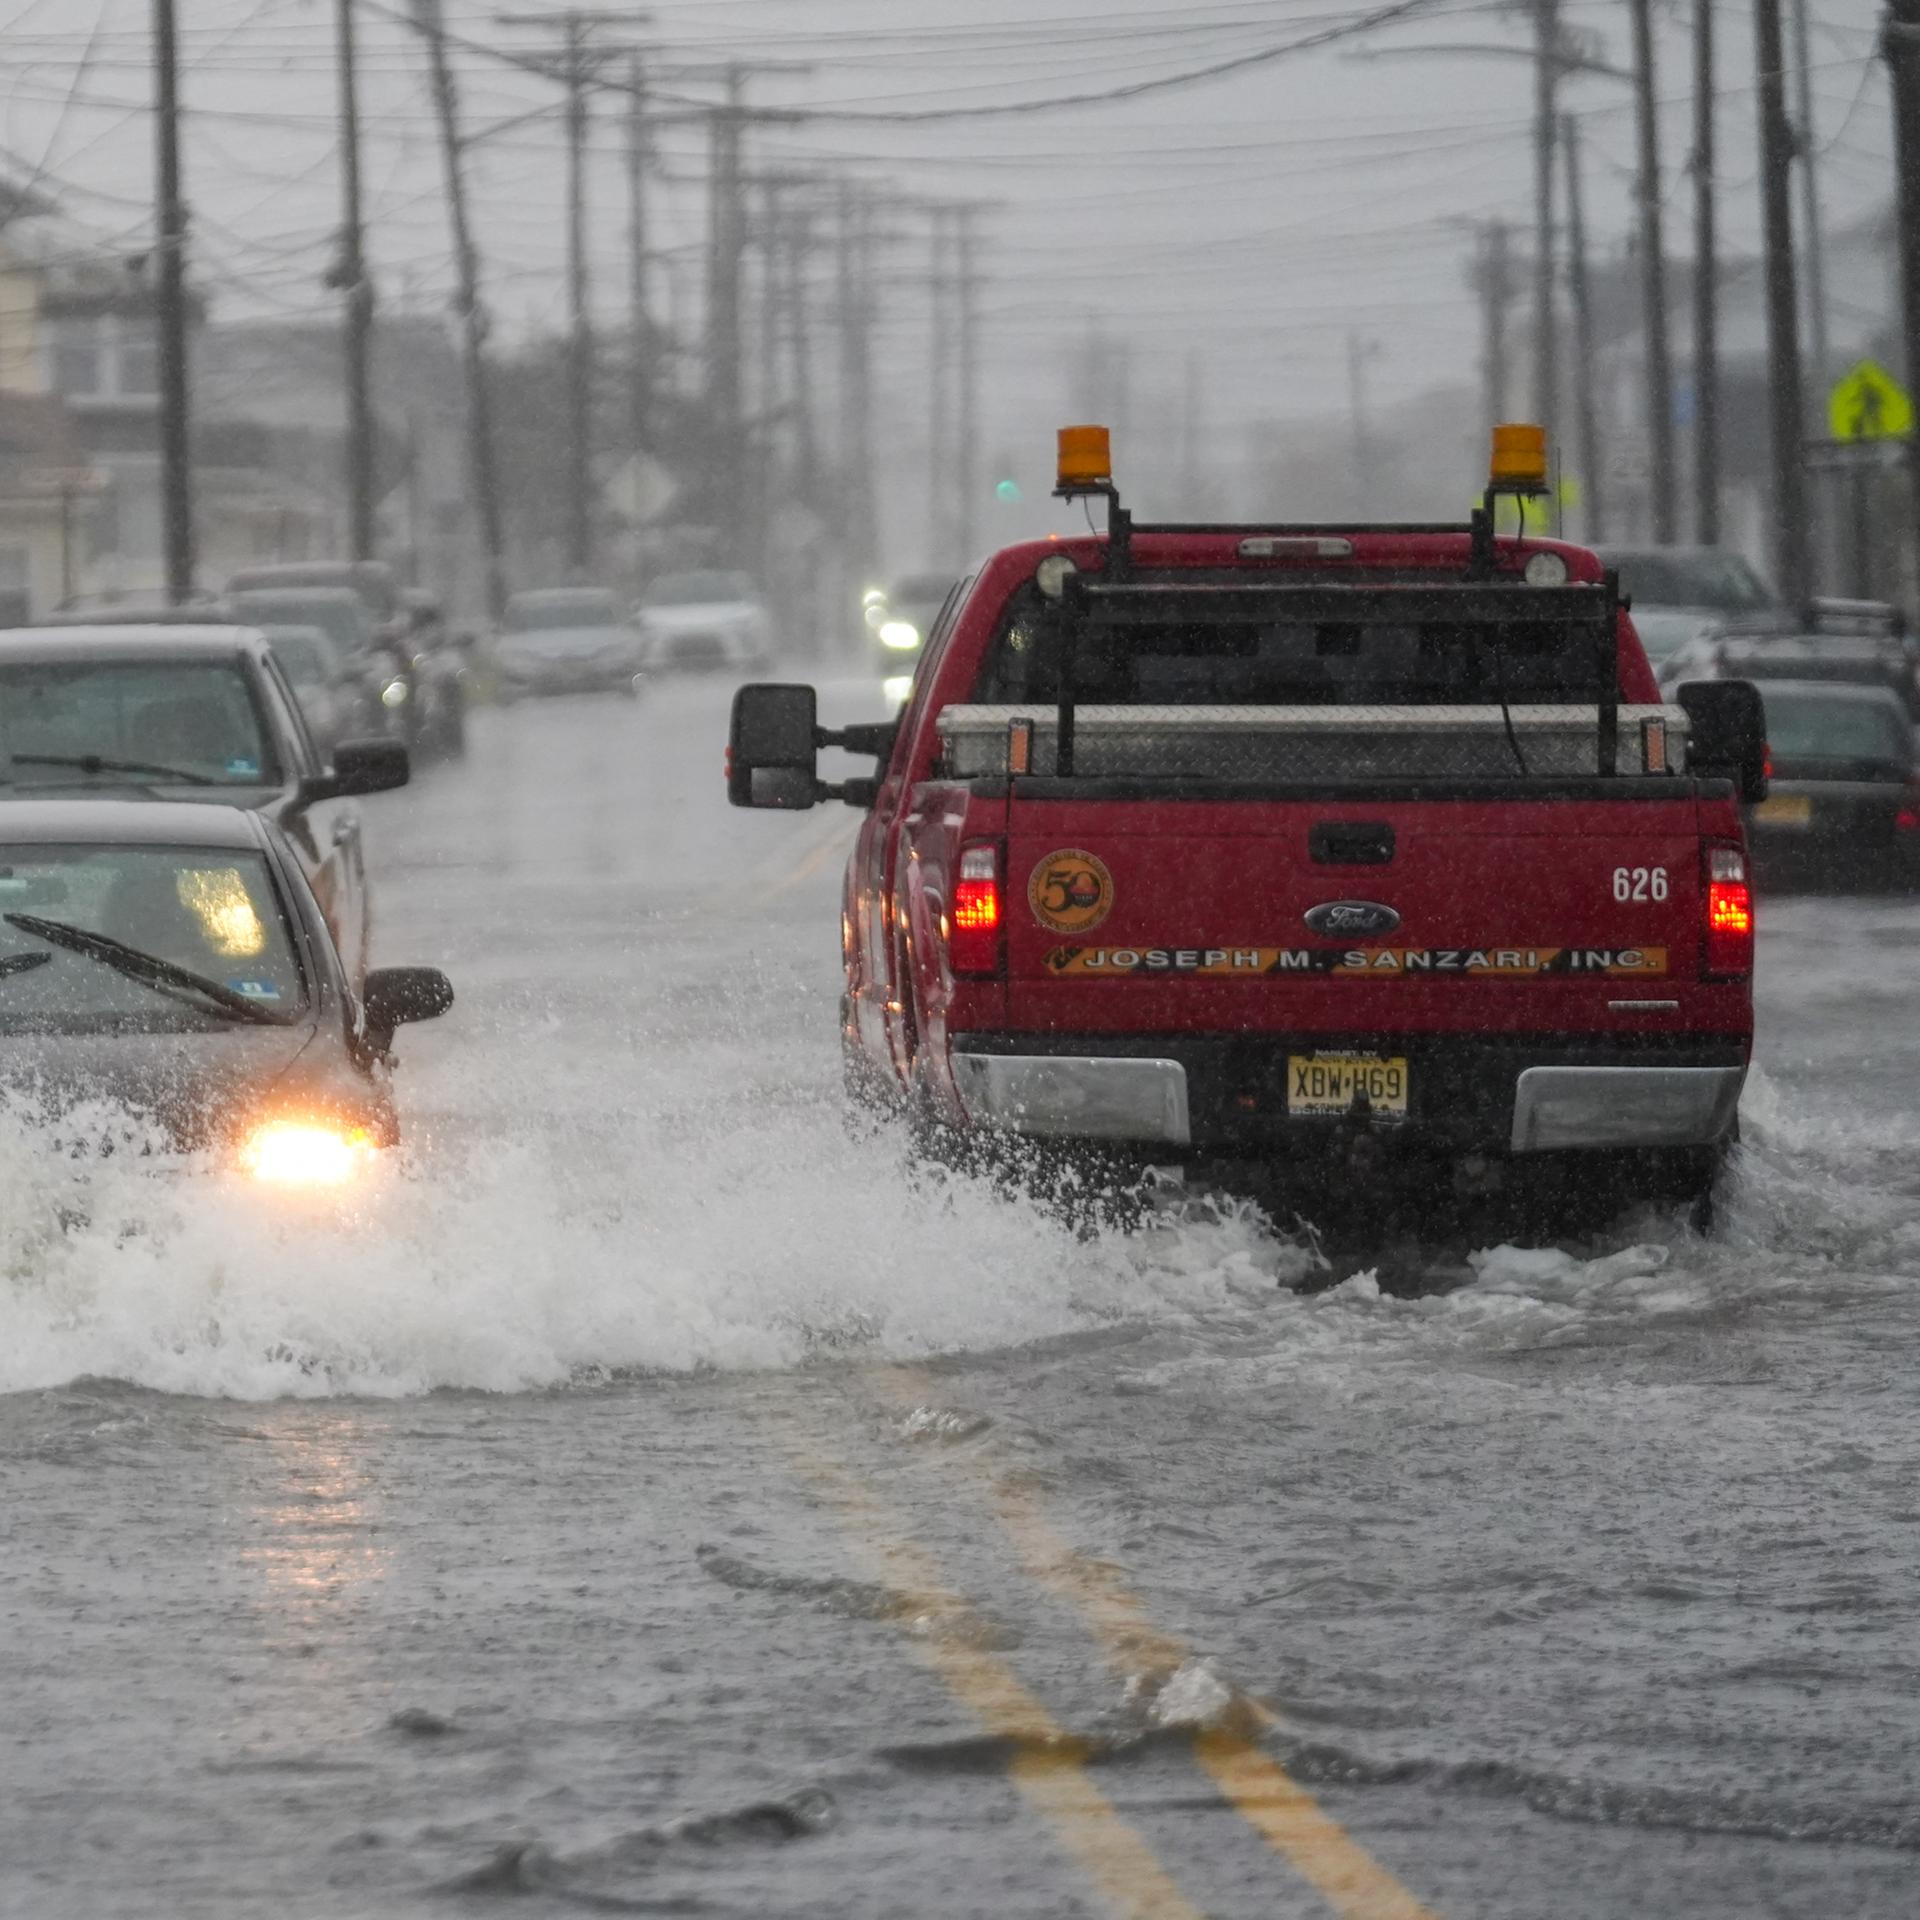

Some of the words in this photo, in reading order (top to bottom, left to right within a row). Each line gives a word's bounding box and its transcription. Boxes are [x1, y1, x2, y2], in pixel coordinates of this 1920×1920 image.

[1041, 870, 1101, 911] 50
[1613, 867, 1668, 902] 626
[1326, 906, 1378, 928] Ford
[1085, 950, 1259, 967] JOSEPH
[1279, 950, 1323, 967] M.
[1569, 950, 1657, 967] INC.
